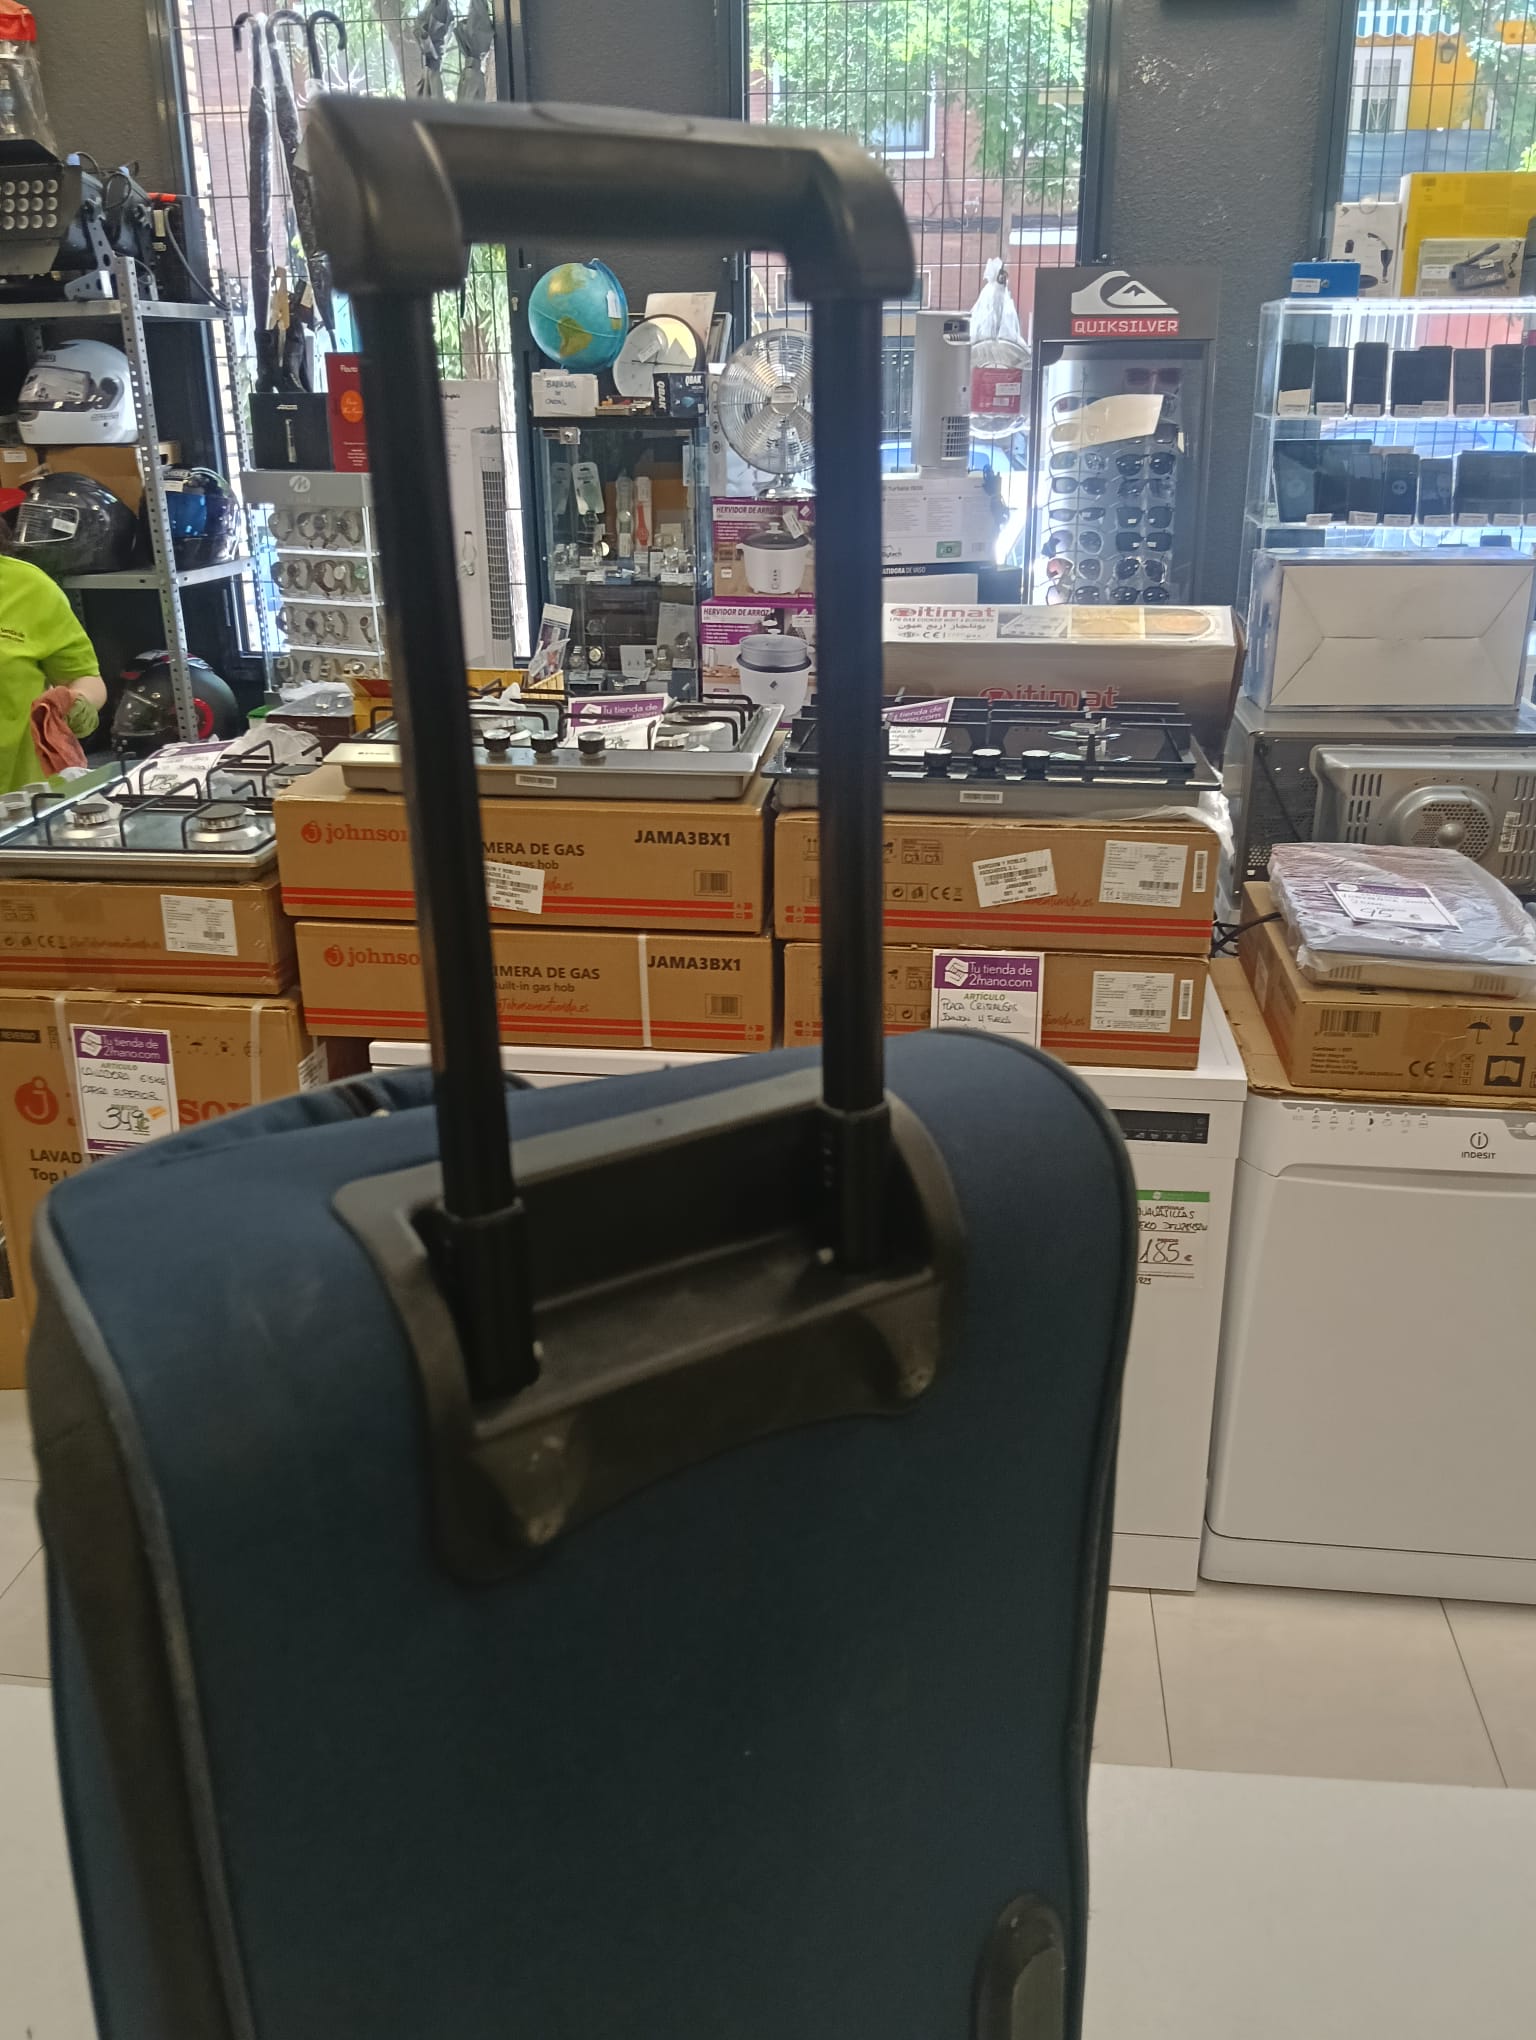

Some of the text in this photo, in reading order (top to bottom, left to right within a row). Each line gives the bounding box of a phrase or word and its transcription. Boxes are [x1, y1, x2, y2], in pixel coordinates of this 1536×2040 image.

[1074, 320, 1178, 333] QUIKSILVER
[716, 506, 747, 514] HERVIDOR
[882, 566, 905, 575] ATIDORA
[703, 608, 737, 616] HERVIDOR
[738, 608, 747, 616] DE
[614, 703, 643, 714] tienda
[634, 830, 730, 846] JAMA3BX1
[483, 842, 585, 857] MERA DE GAS
[348, 947, 420, 967] johnso
[648, 955, 741, 971] JAMA3BX1
[495, 965, 600, 980] IMERA DE GAS
[969, 961, 1033, 976] Tu tienda de
[532, 984, 551, 993] gas
[554, 982, 575, 992] hob
[101, 1034, 159, 1049] Tu tienda de
[30, 1148, 83, 1164] LAVAD
[30, 1168, 59, 1184] Top
[1139, 1239, 1180, 1263] 185
